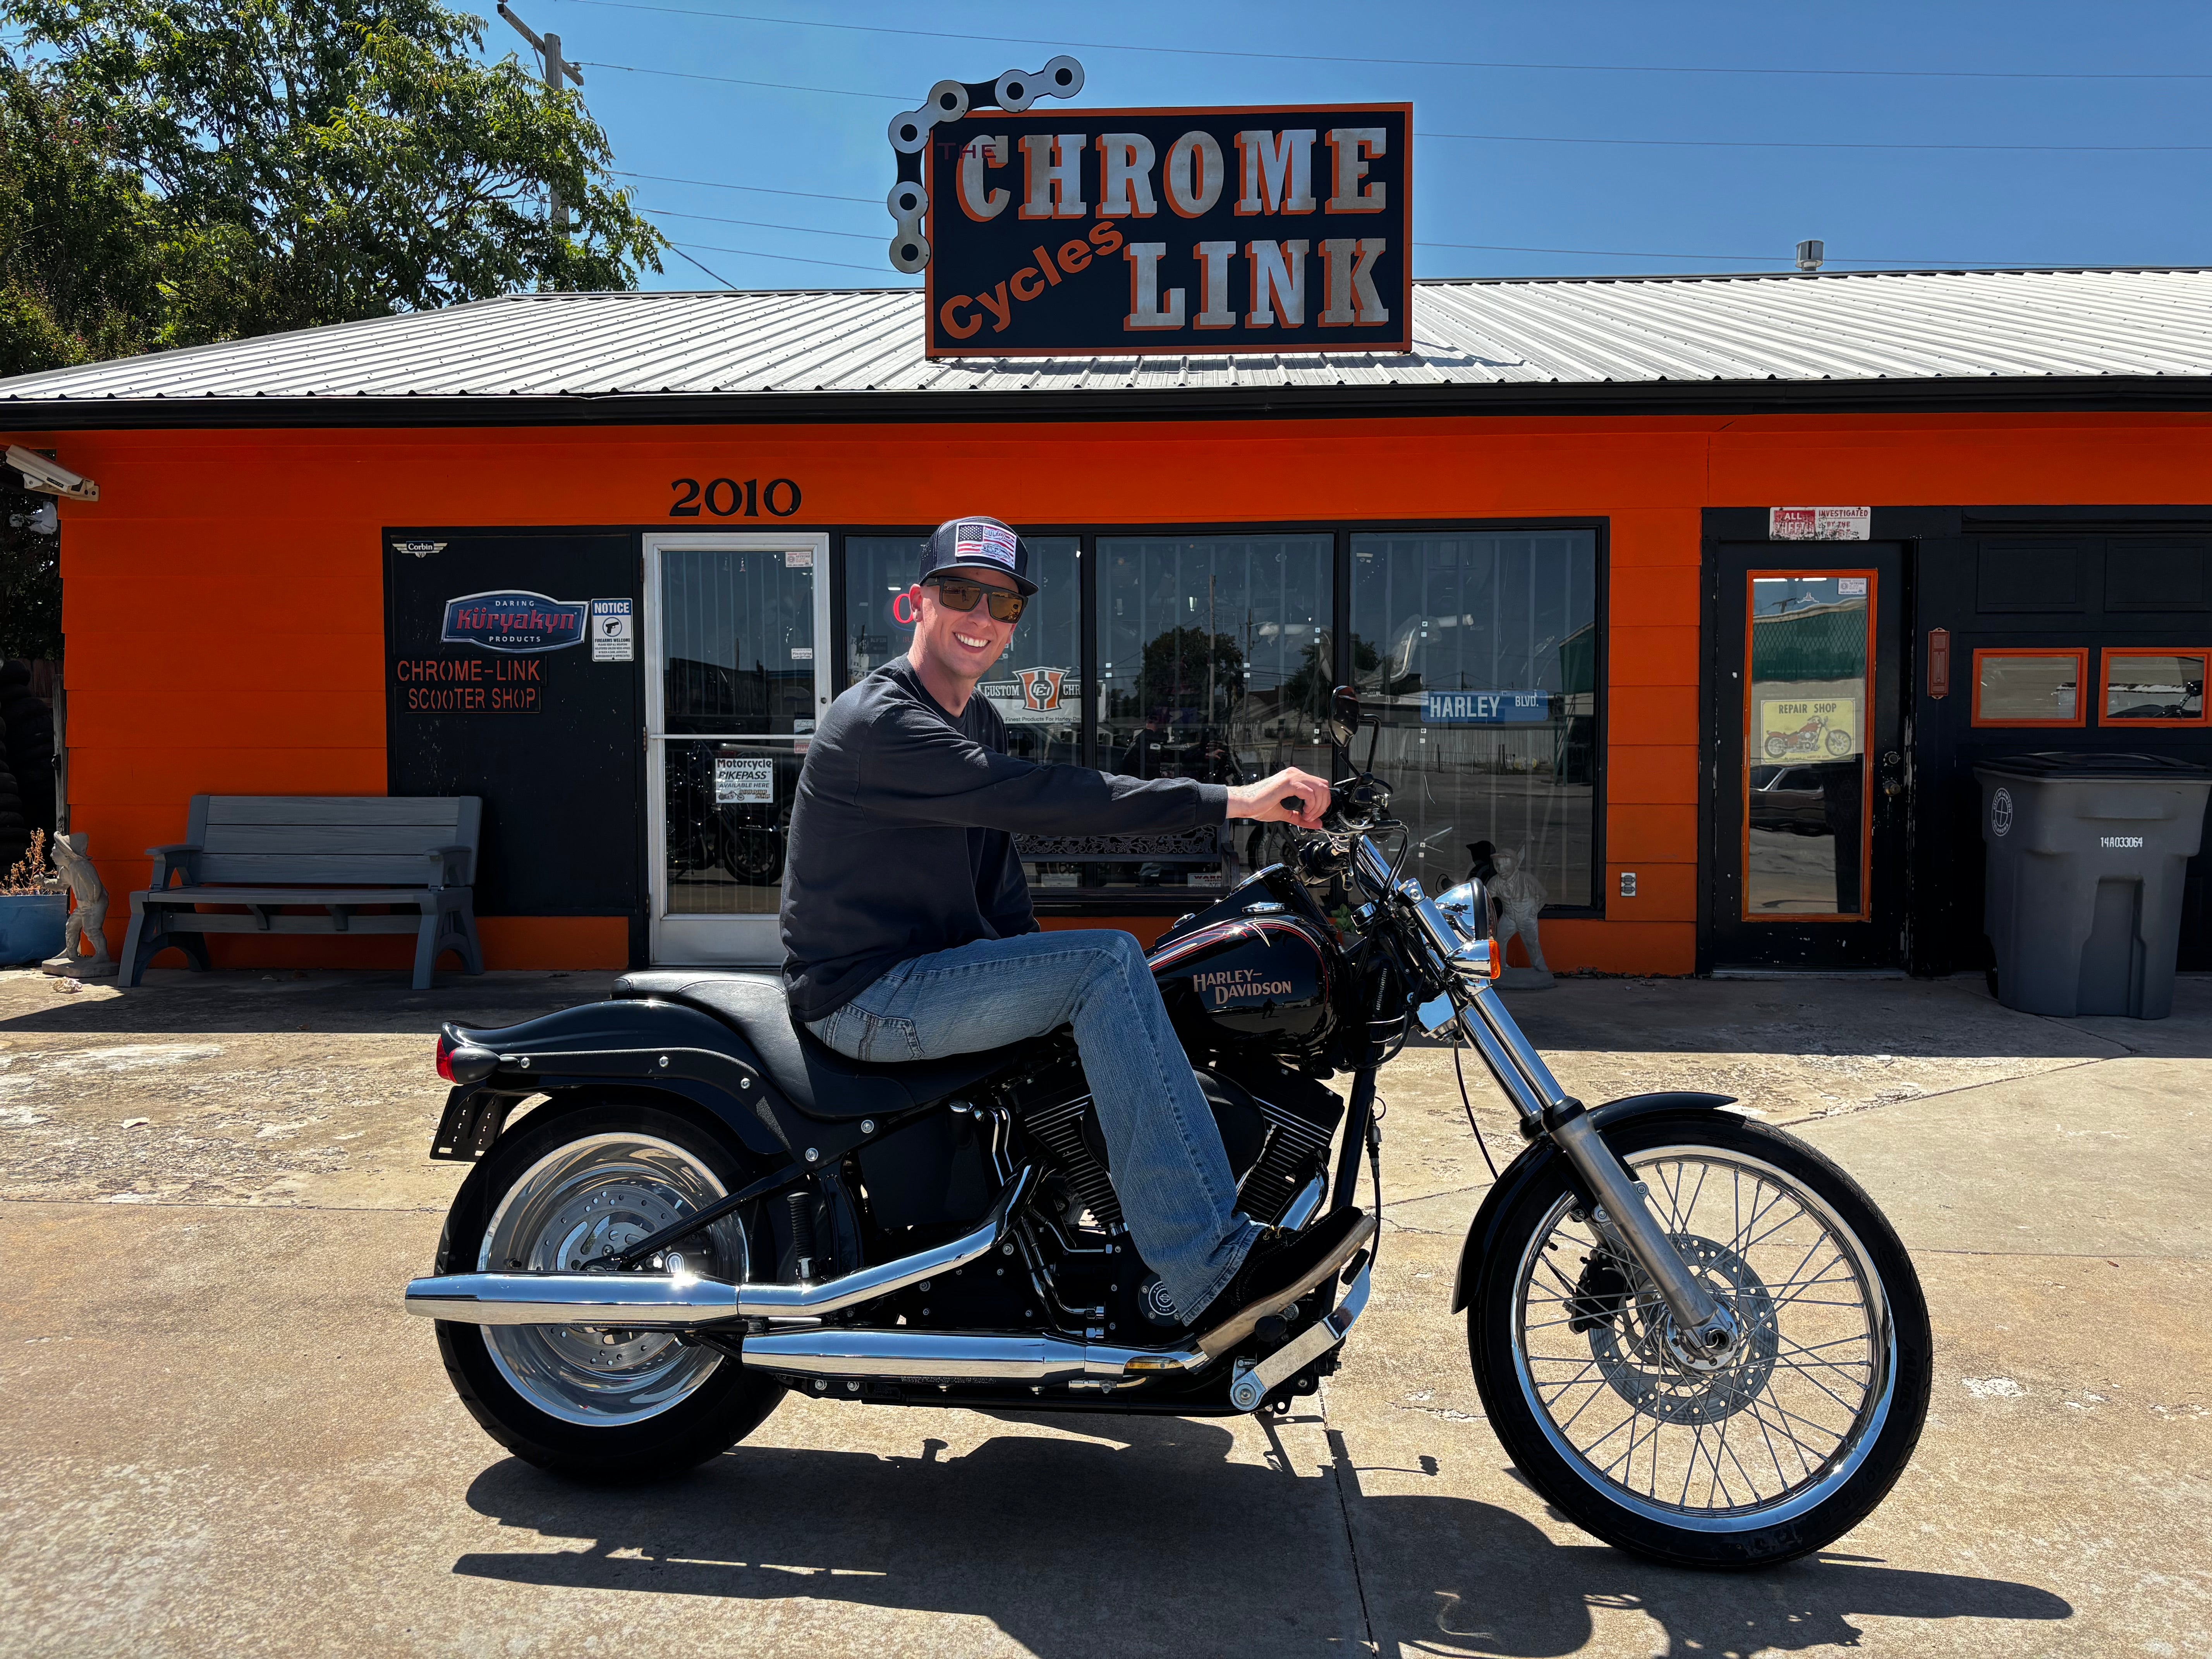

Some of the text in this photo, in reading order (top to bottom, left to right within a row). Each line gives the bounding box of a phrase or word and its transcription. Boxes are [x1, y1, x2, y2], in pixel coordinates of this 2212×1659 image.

[937, 143, 996, 160] THE
[956, 128, 1387, 222] CHROME
[940, 221, 1123, 340] Cycles
[1123, 238, 1389, 331] LINK
[669, 478, 802, 517] 2010
[594, 603, 630, 613] NOTICE
[456, 607, 574, 634] Küryakyn
[397, 660, 540, 681] CHROME-LINK
[409, 688, 536, 709] SCOOTER SHOP
[985, 685, 1019, 696] CUSTOM
[1063, 684, 1081, 696] CHR
[1430, 696, 1539, 717] HARLEY BLVD.
[1779, 703, 1836, 714] REPAIR SHOP
[717, 759, 771, 770] Motorcycle
[718, 771, 767, 780] PIKEPASS
[2100, 837, 2142, 847] 14A033064
[1193, 969, 1262, 992] HARLEY-
[1215, 981, 1291, 1005] DAVIDSON
